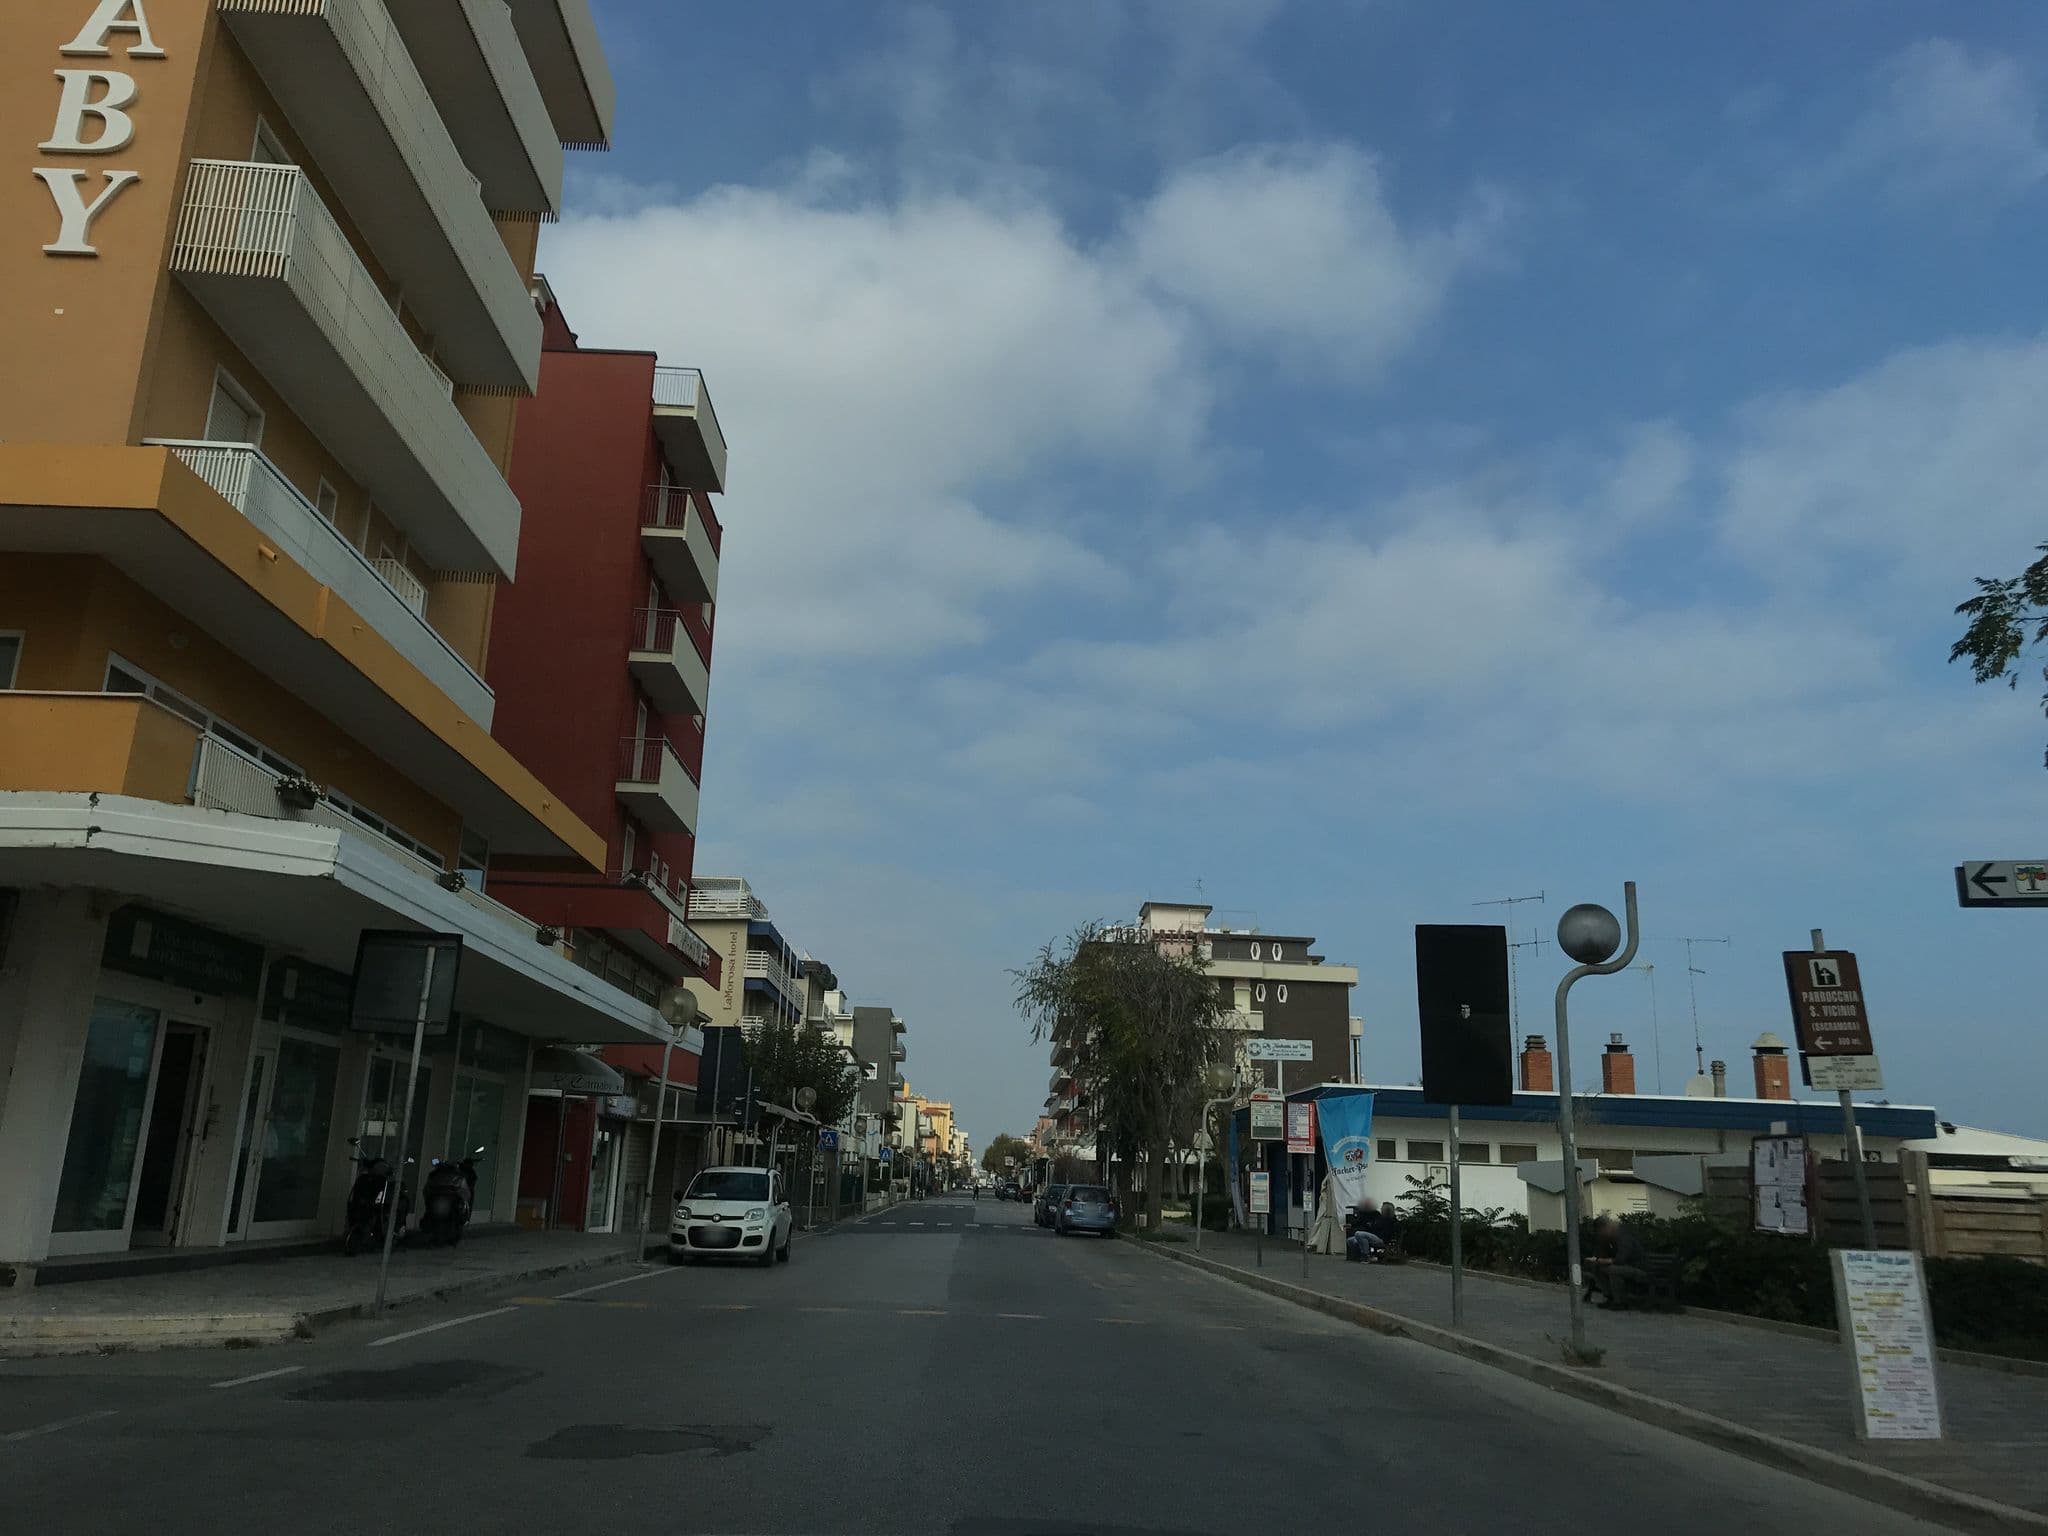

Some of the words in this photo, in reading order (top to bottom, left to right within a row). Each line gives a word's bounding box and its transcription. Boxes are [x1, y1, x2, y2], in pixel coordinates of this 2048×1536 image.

[728, 931, 738, 957] hotel
[723, 959, 737, 1011] LaMorosa
[1802, 990, 1860, 1003] PARROCCHIA
[1809, 1005, 1820, 1018] S.
[1822, 1004, 1857, 1017] VICINIO
